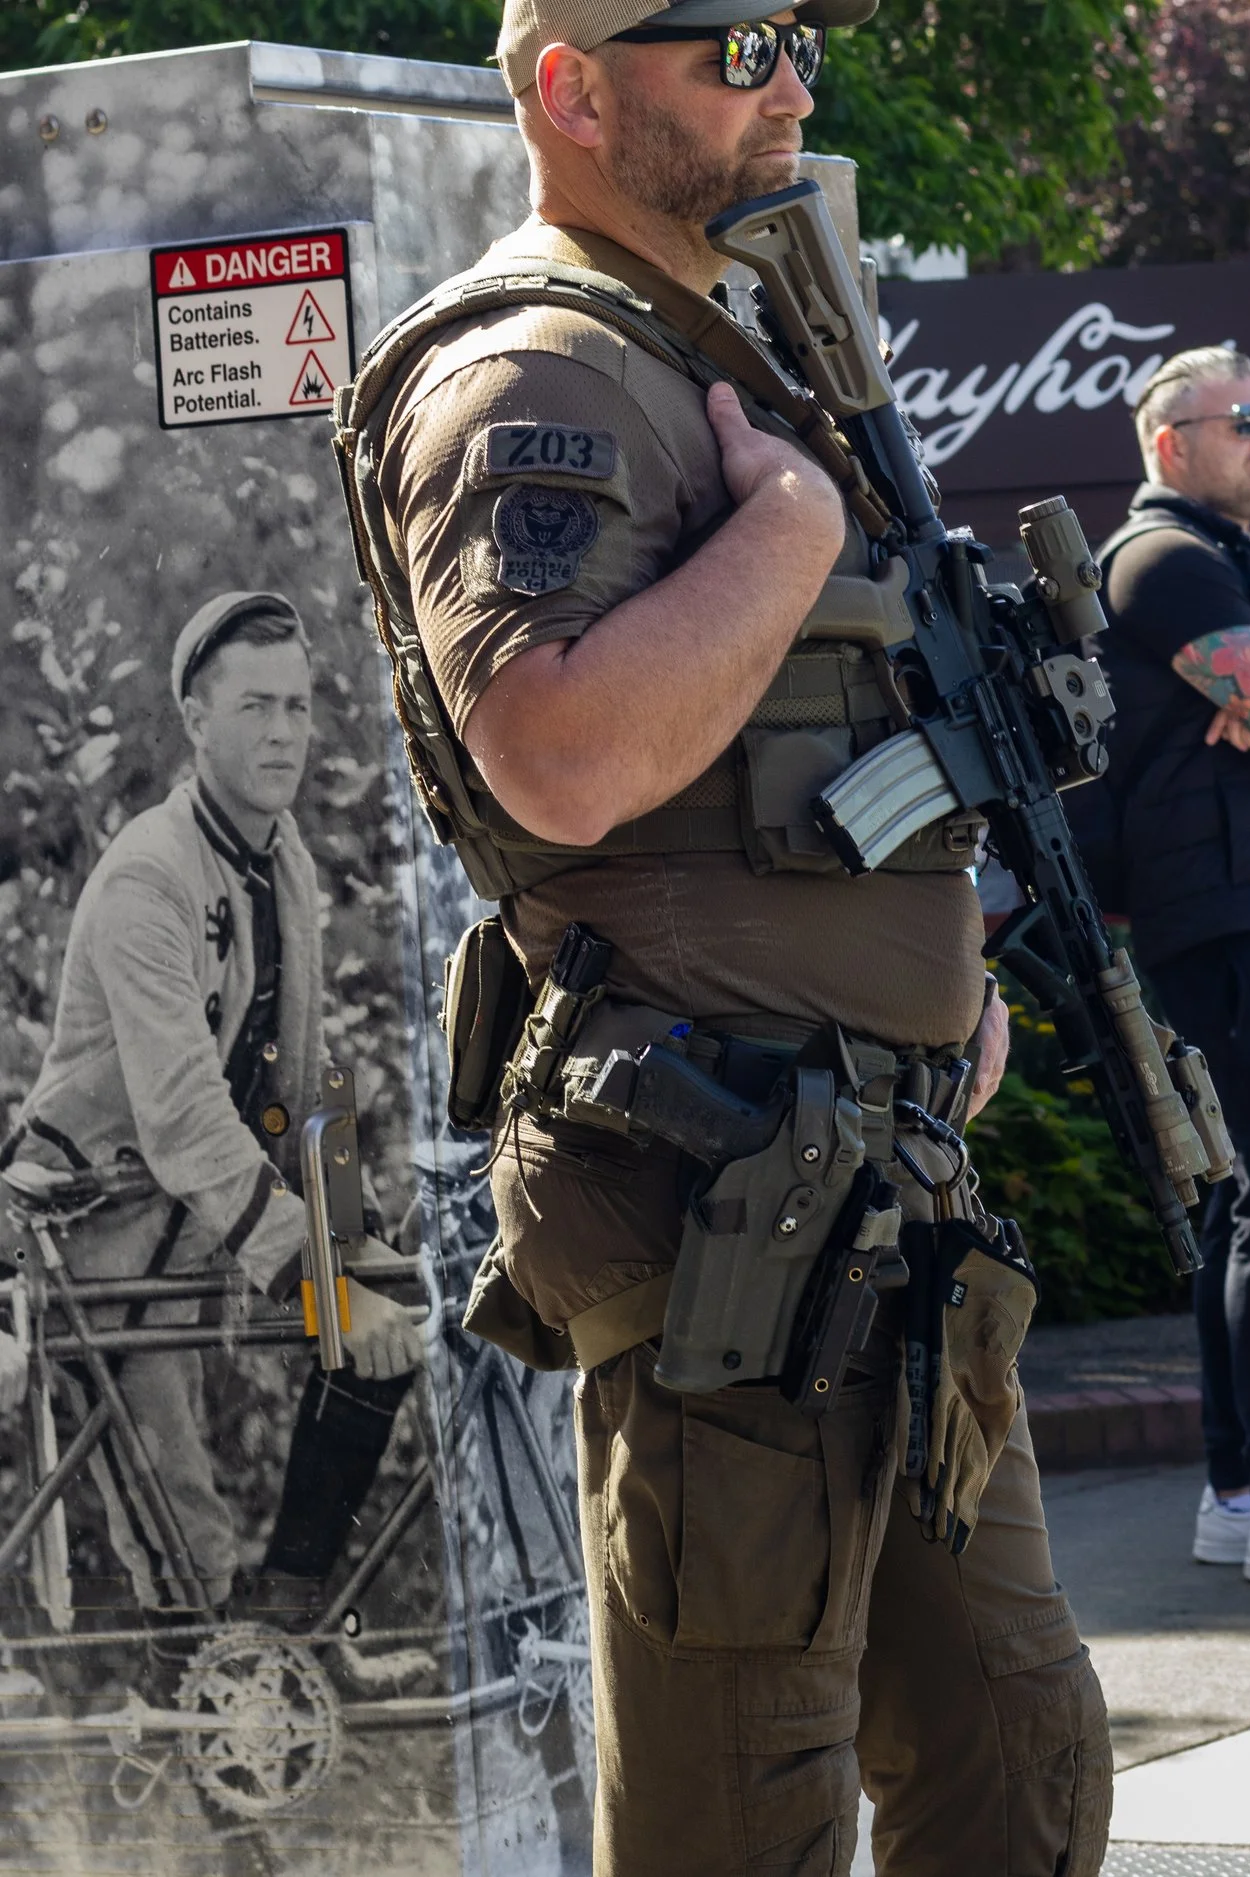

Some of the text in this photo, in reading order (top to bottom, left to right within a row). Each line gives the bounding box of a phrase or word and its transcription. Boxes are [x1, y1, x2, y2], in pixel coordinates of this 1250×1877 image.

[205, 241, 331, 284] DANGER
[168, 300, 253, 326] Contains
[170, 328, 260, 353] Batteries.
[173, 360, 263, 388] Arc Flash
[173, 388, 262, 415] Potential.
[508, 429, 595, 470] Z03
[505, 567, 571, 579] POLICE
